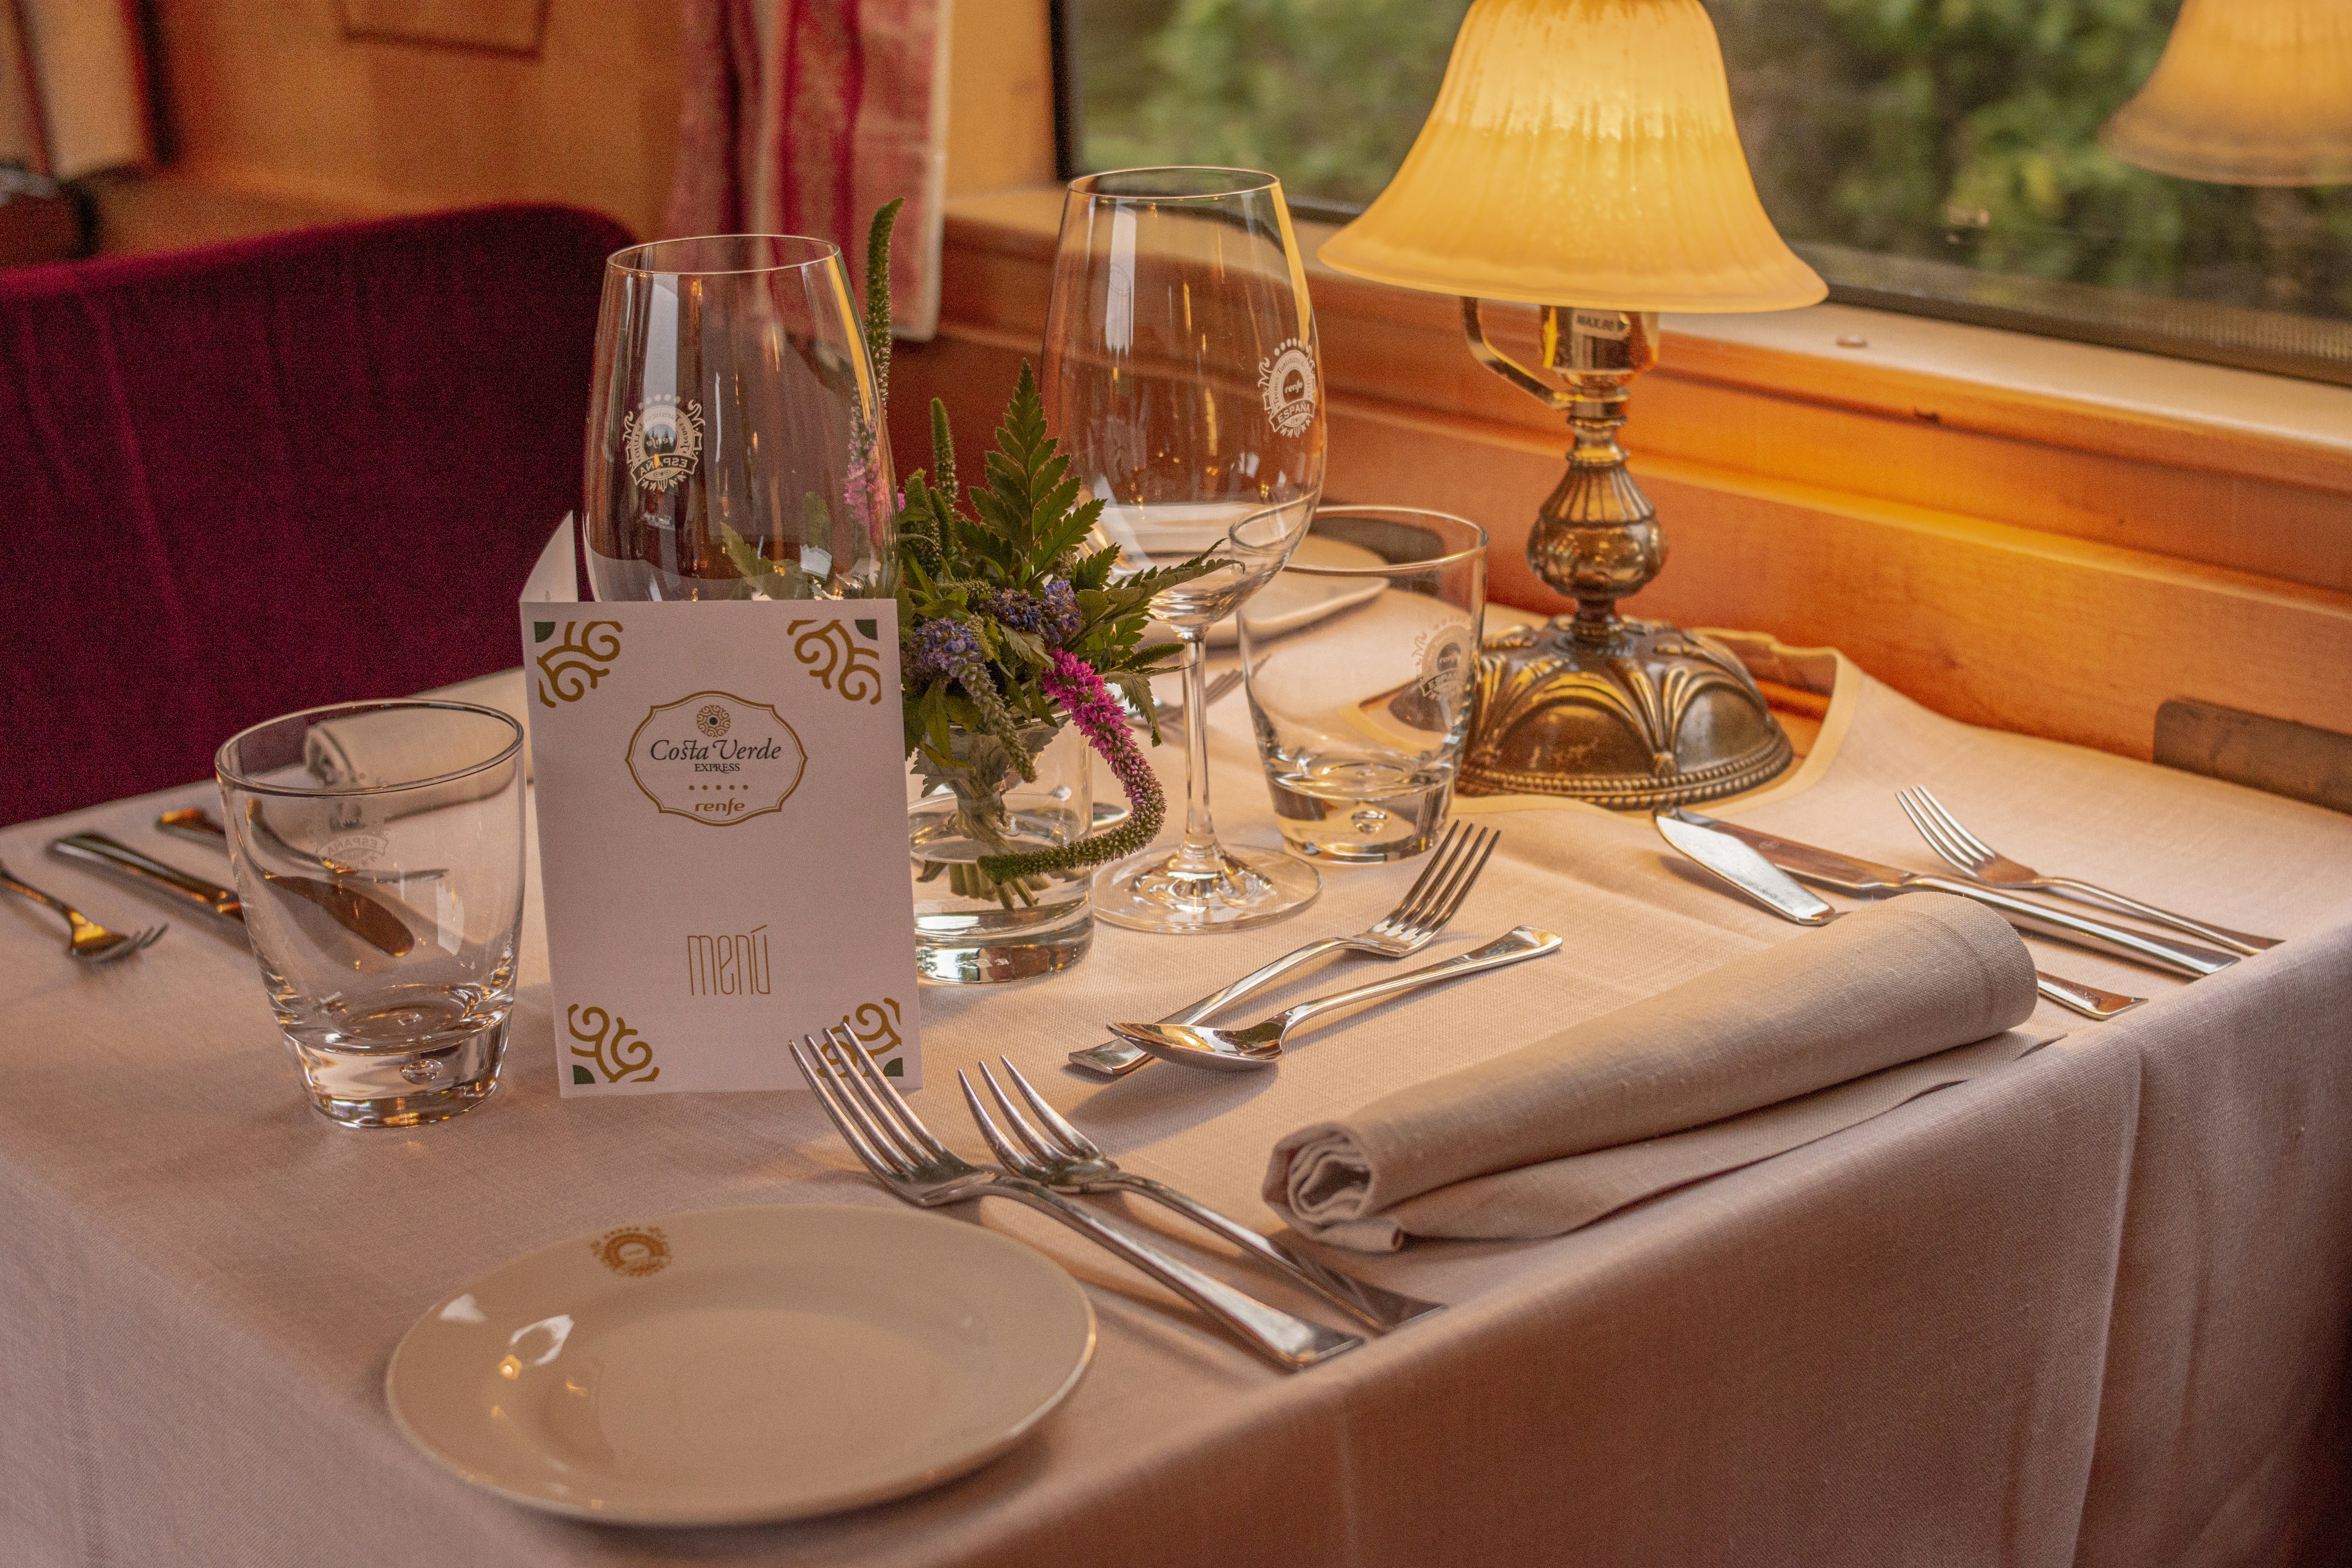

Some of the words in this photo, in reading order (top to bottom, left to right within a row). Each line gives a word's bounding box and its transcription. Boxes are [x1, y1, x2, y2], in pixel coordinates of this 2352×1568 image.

[1285, 379, 1303, 394] renfe
[1277, 401, 1310, 423] ESPAÑA
[650, 739, 709, 760] Costa
[713, 738, 782, 760] Verde
[695, 763, 740, 773] EXPRESS
[695, 798, 745, 816] renfe
[688, 924, 771, 996] menú
